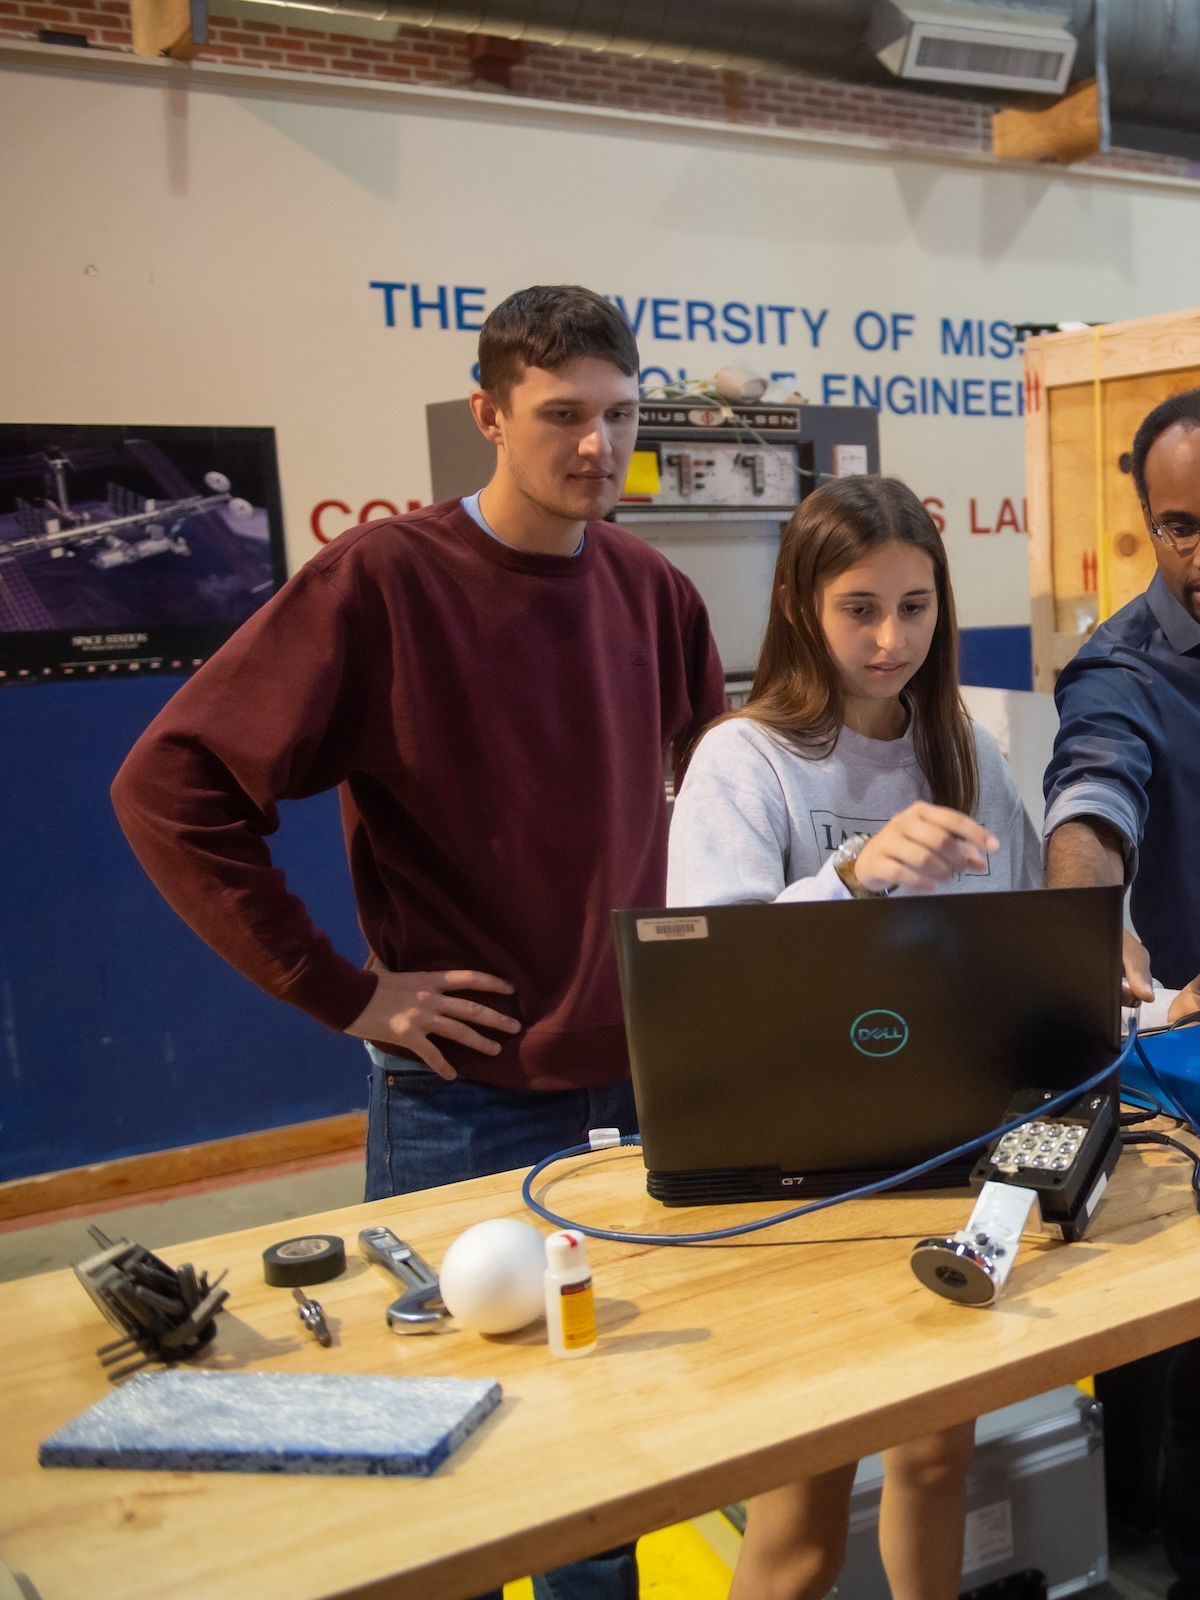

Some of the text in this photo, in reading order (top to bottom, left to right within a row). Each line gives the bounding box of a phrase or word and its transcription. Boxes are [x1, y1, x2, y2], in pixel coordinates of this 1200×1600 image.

[369, 281, 486, 331] THE
[854, 310, 915, 352] OF
[858, 1027, 903, 1040] DELL
[781, 1177, 804, 1186] G7
